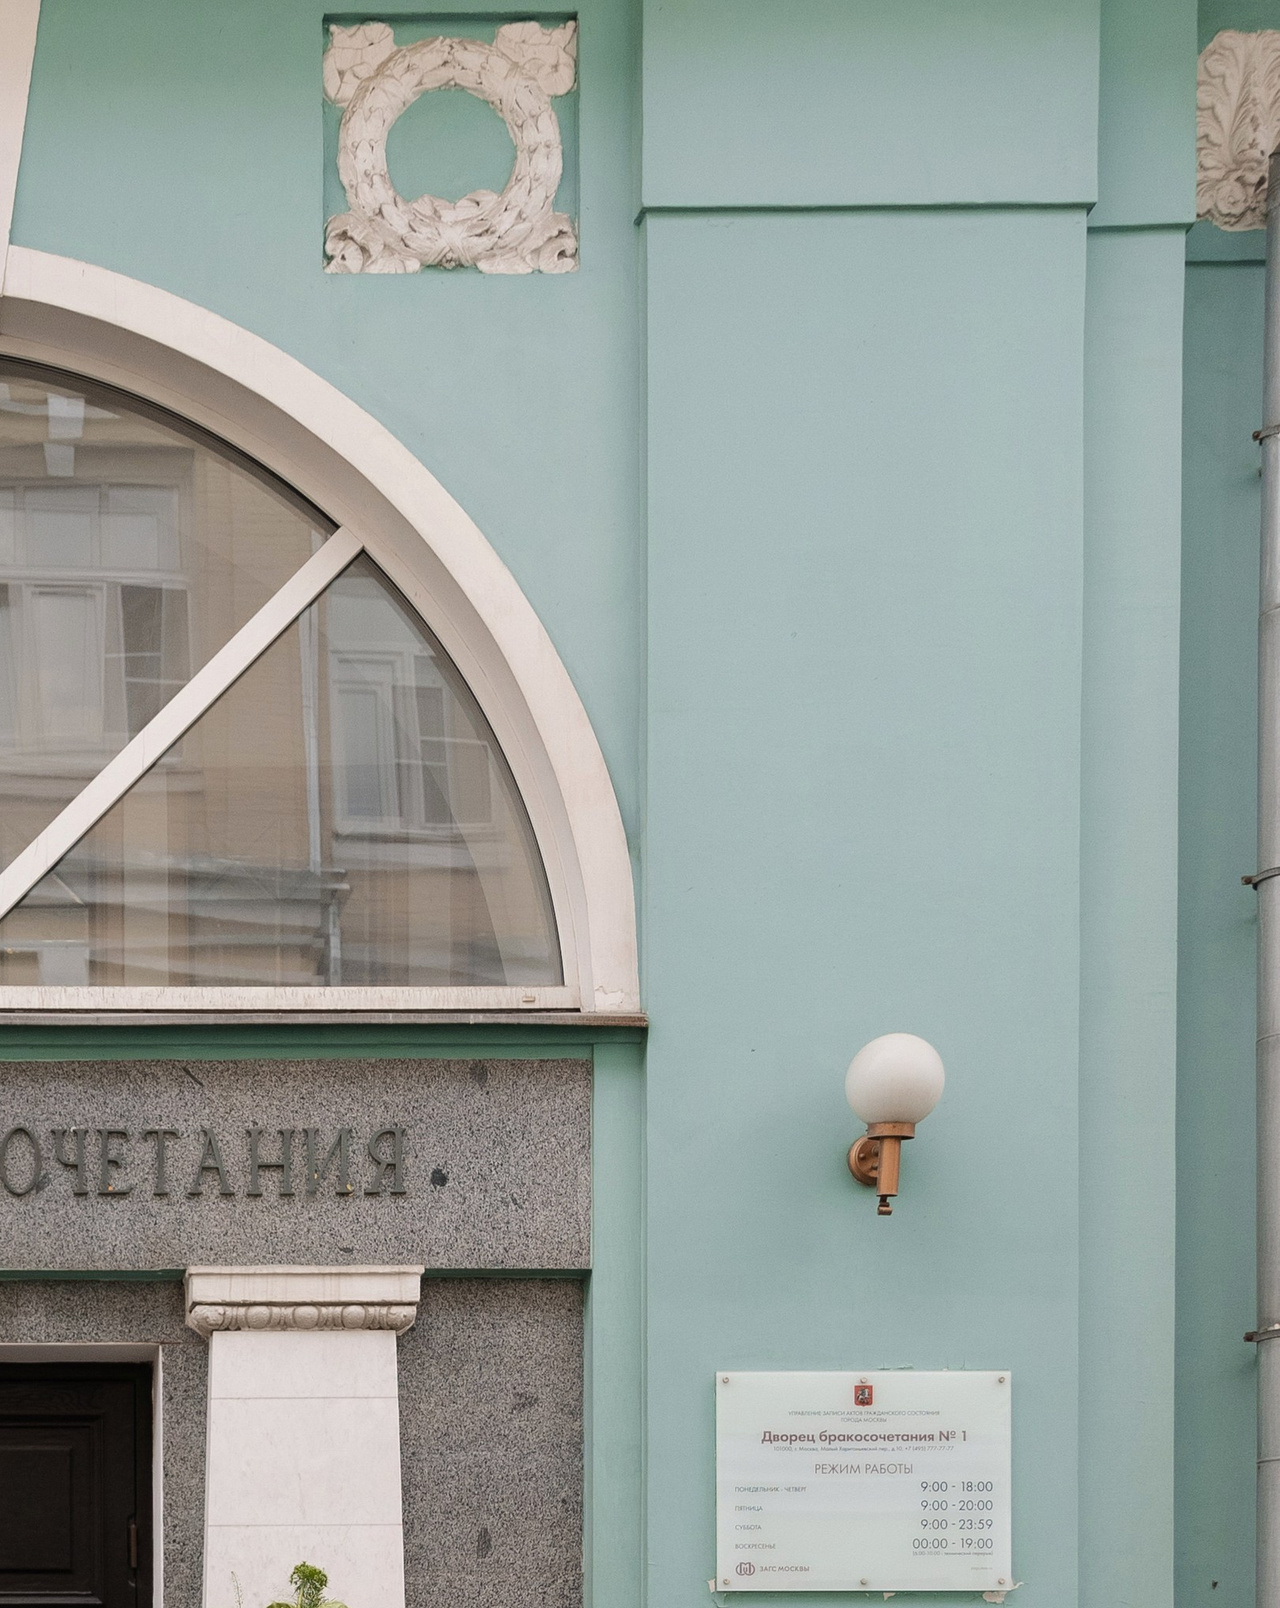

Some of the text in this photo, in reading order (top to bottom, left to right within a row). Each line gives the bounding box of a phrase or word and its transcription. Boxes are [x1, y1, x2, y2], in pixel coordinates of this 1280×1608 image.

[761, 1430, 967, 1445] Дворец бракосочетания № 1
[814, 1463, 913, 1475] РЕЖИМ РАБОТЫ
[920, 1481, 948, 1492] 9:00
[961, 1481, 994, 1492] 18:00
[920, 1500, 948, 1511] 9:00
[958, 1500, 994, 1511] 20:00
[920, 1519, 948, 1530] 9:00
[958, 1519, 994, 1530] 23:59
[912, 1538, 948, 1549] 00:00
[961, 1538, 994, 1549] 19:00
